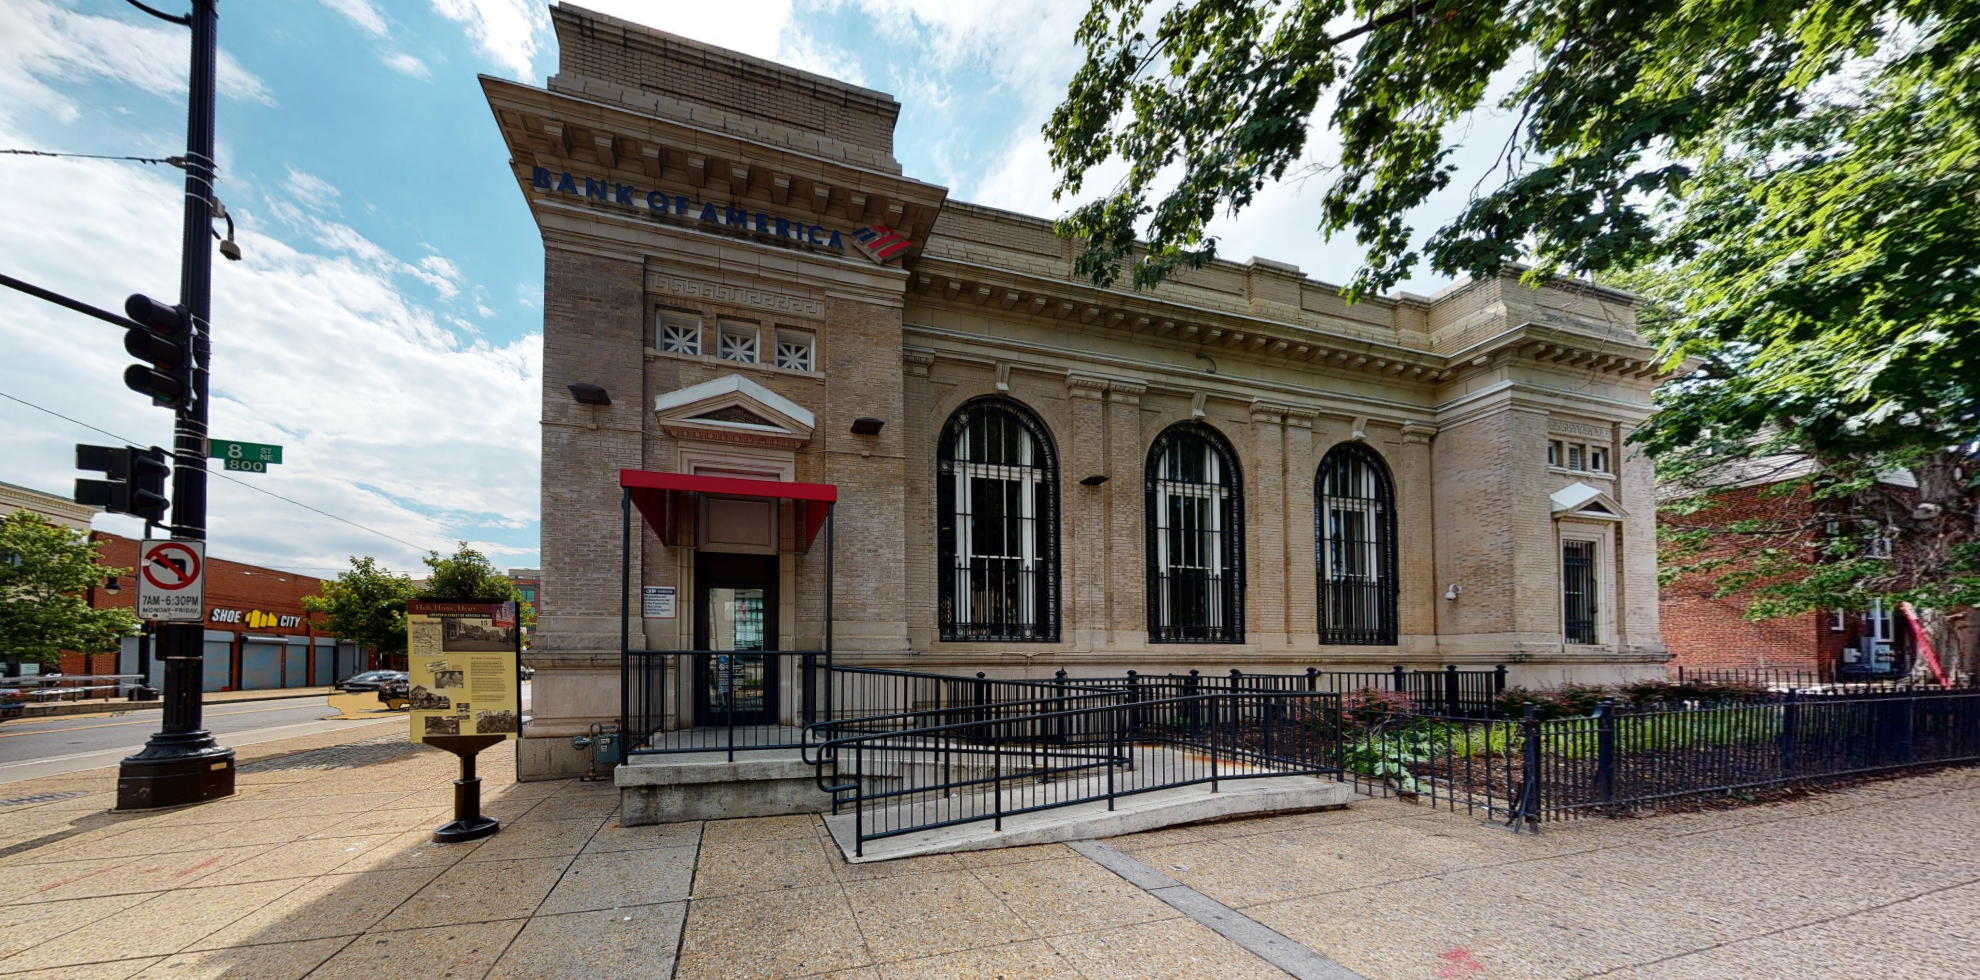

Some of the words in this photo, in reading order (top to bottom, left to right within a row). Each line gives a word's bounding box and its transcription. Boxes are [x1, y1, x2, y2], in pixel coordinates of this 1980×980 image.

[532, 165, 635, 207] BANK
[646, 190, 690, 216] OF
[699, 202, 845, 250] AMERICA
[227, 443, 243, 459] 8
[260, 447, 273, 455] ST
[229, 460, 264, 472] 800
[142, 595, 199, 606] 7AM-6:30PM
[415, 604, 432, 612] Hub,
[211, 608, 242, 623] SHOE
[280, 615, 301, 628] CITY
